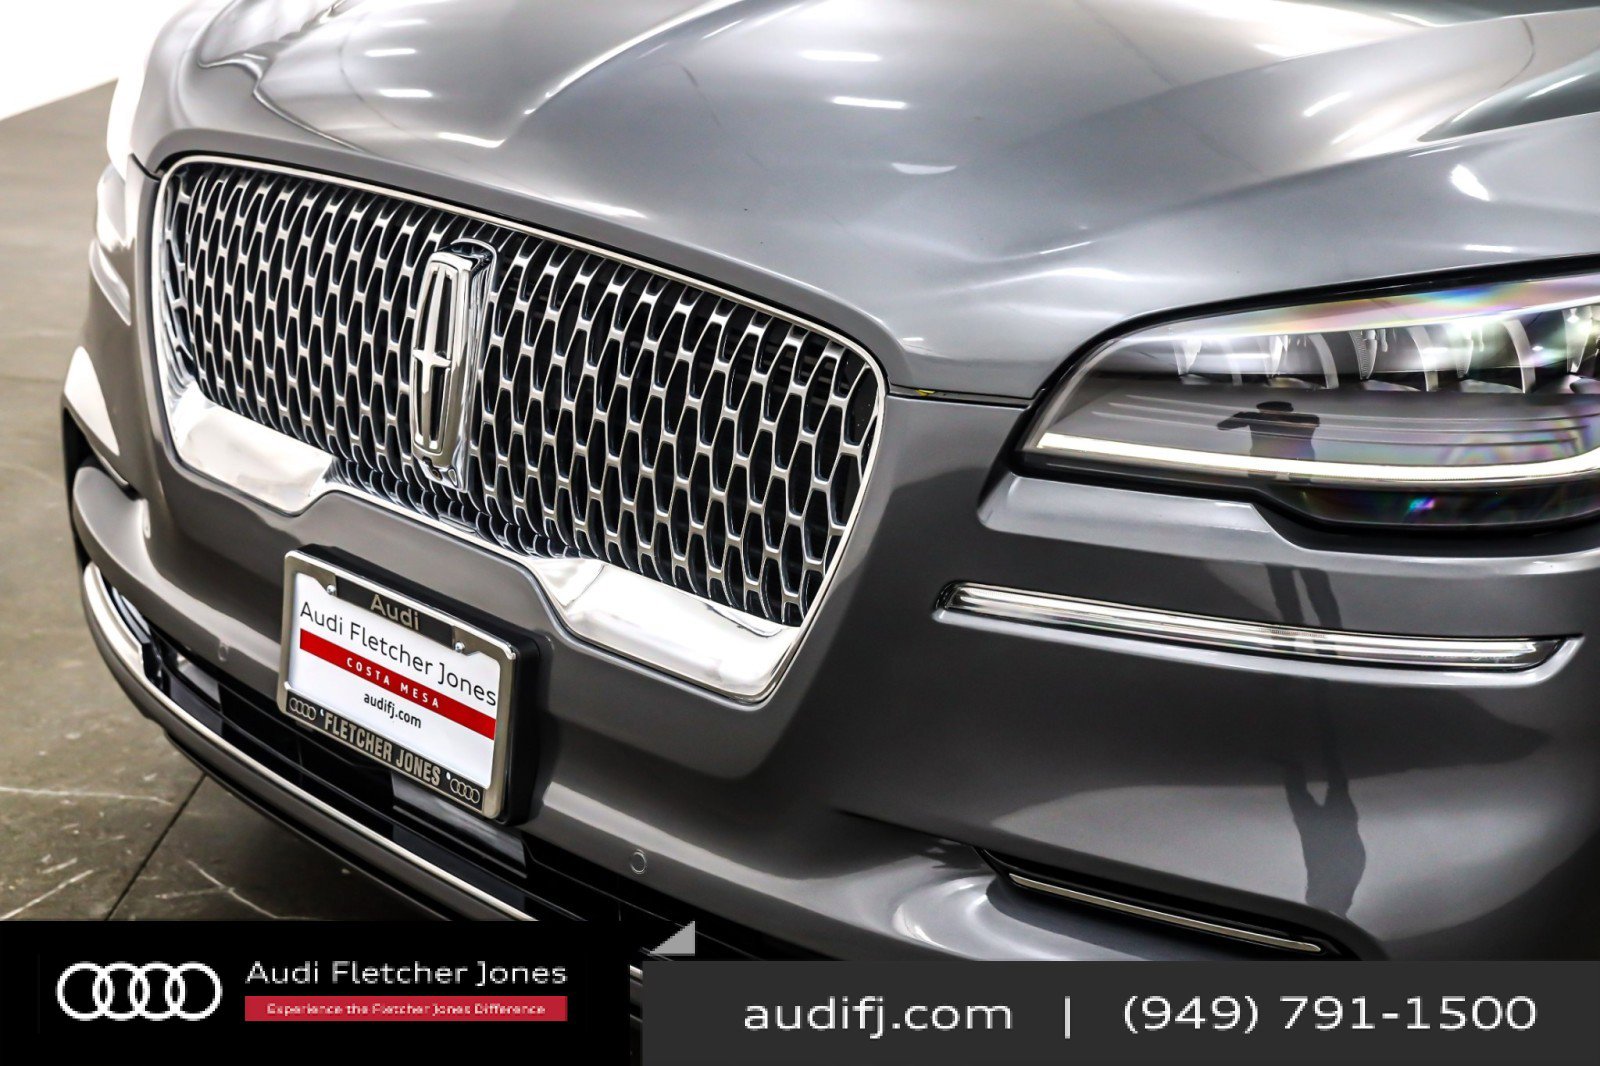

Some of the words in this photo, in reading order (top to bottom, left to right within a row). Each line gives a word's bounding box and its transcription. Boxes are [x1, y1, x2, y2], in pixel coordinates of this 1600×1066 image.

[370, 594, 420, 631] Audi
[300, 601, 343, 635] Audi
[350, 622, 434, 675] Fletcher
[437, 662, 497, 706] Jones
[346, 657, 390, 686] COSTA
[400, 682, 439, 708] MESA
[363, 692, 422, 729] audifj.com
[323, 712, 392, 762] FLETCHER
[396, 751, 441, 787] JONES
